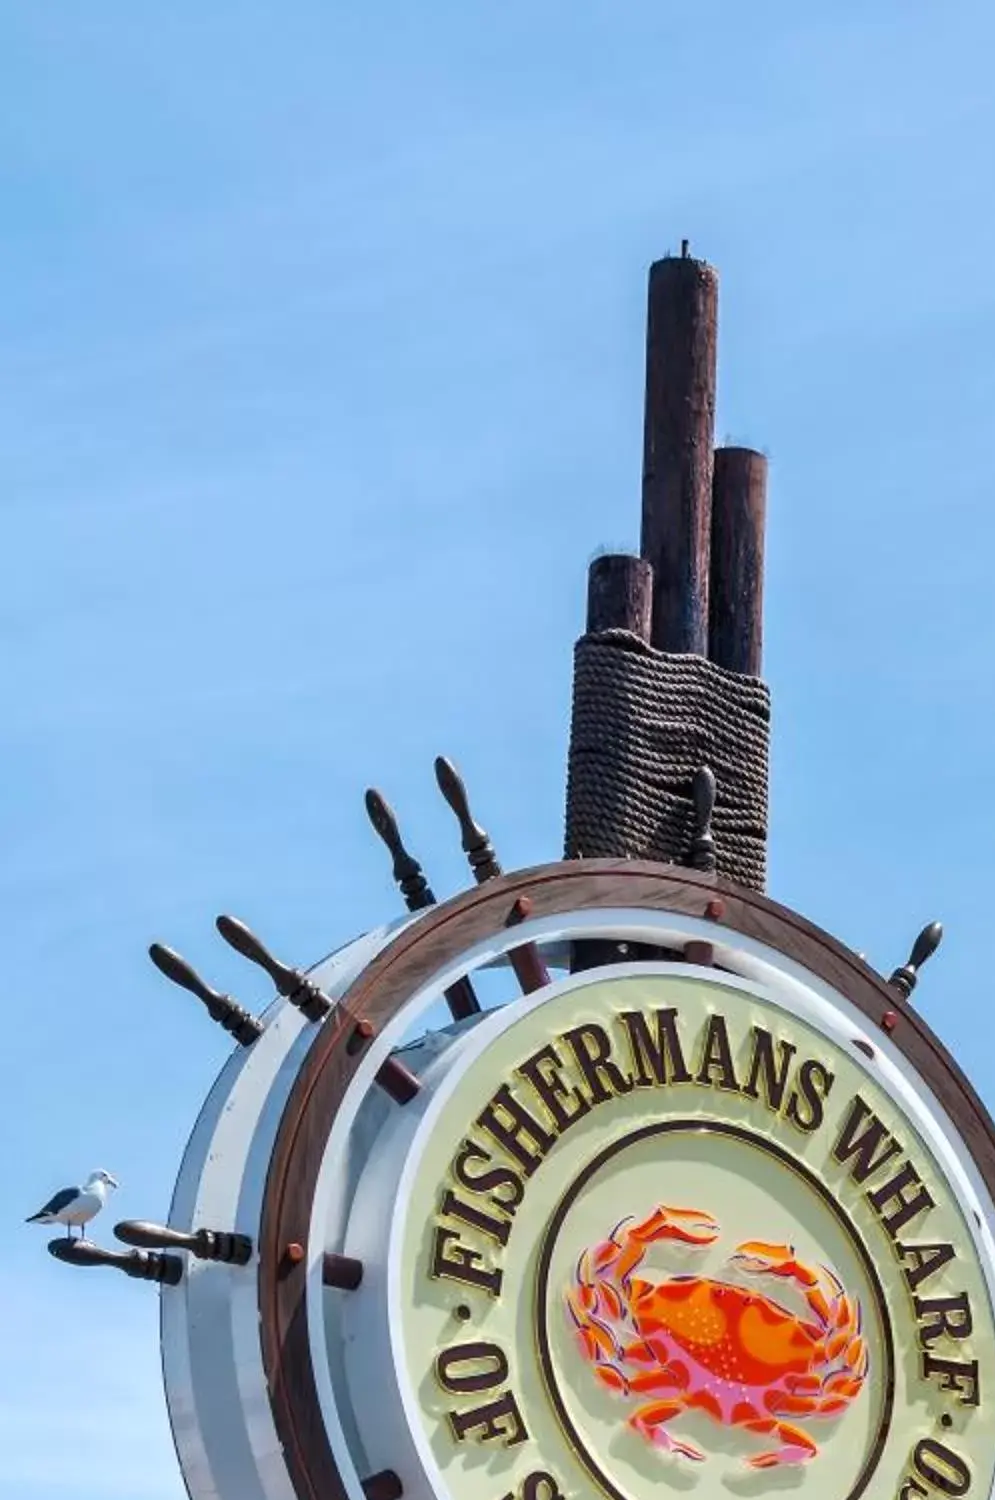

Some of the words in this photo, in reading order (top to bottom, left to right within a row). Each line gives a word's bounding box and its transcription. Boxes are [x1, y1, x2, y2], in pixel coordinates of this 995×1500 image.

[432, 1006, 835, 1298] FISHERMANS
[830, 1093, 980, 1407] WHARF
[435, 1341, 532, 1448] OF
